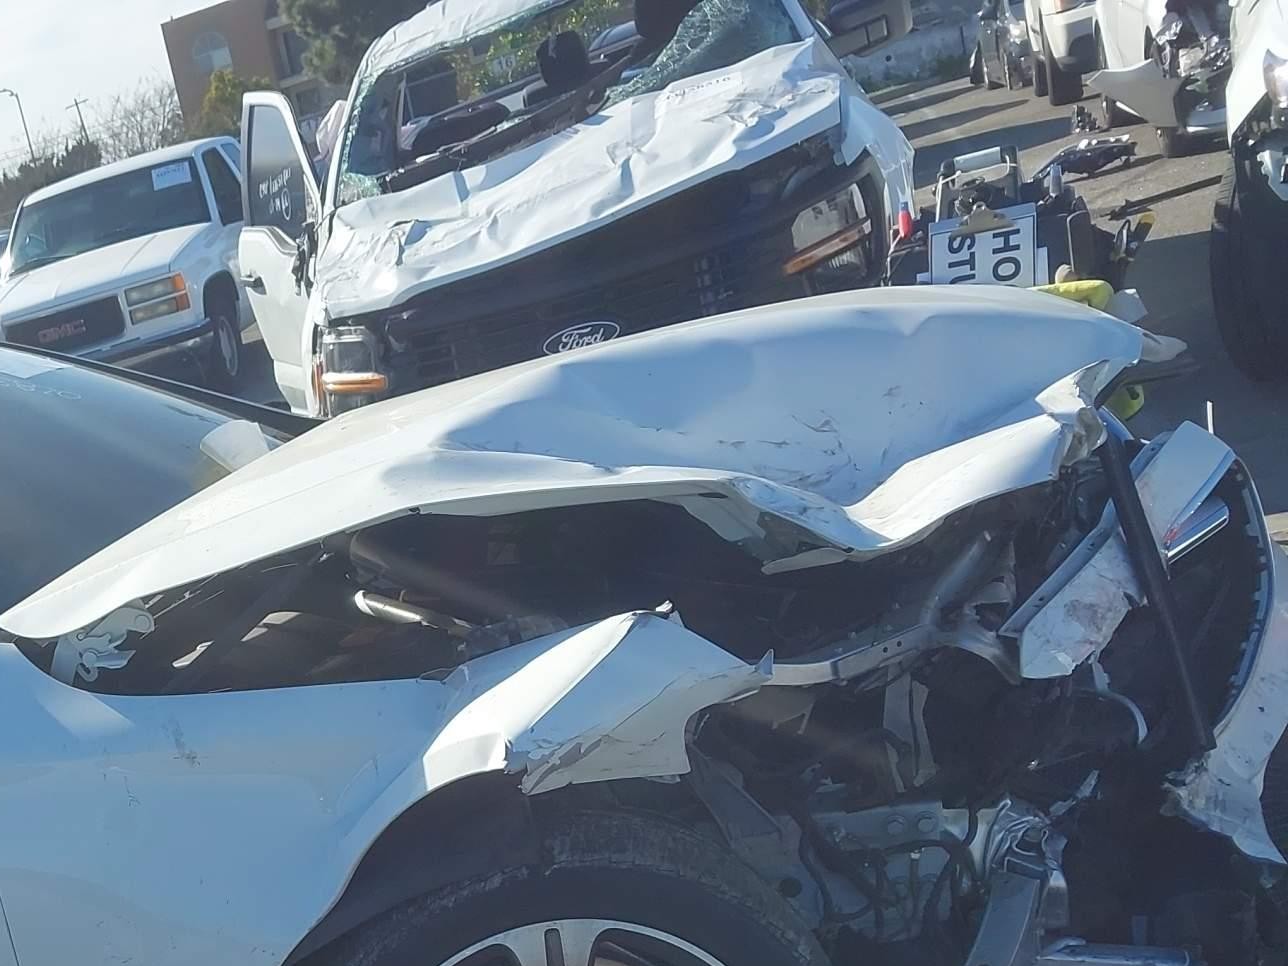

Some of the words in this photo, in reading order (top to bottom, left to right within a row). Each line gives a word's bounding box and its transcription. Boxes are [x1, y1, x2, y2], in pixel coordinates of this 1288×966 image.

[992, 228, 1021, 286] HO
[38, 319, 86, 343] GMC
[558, 326, 604, 352] Ford
